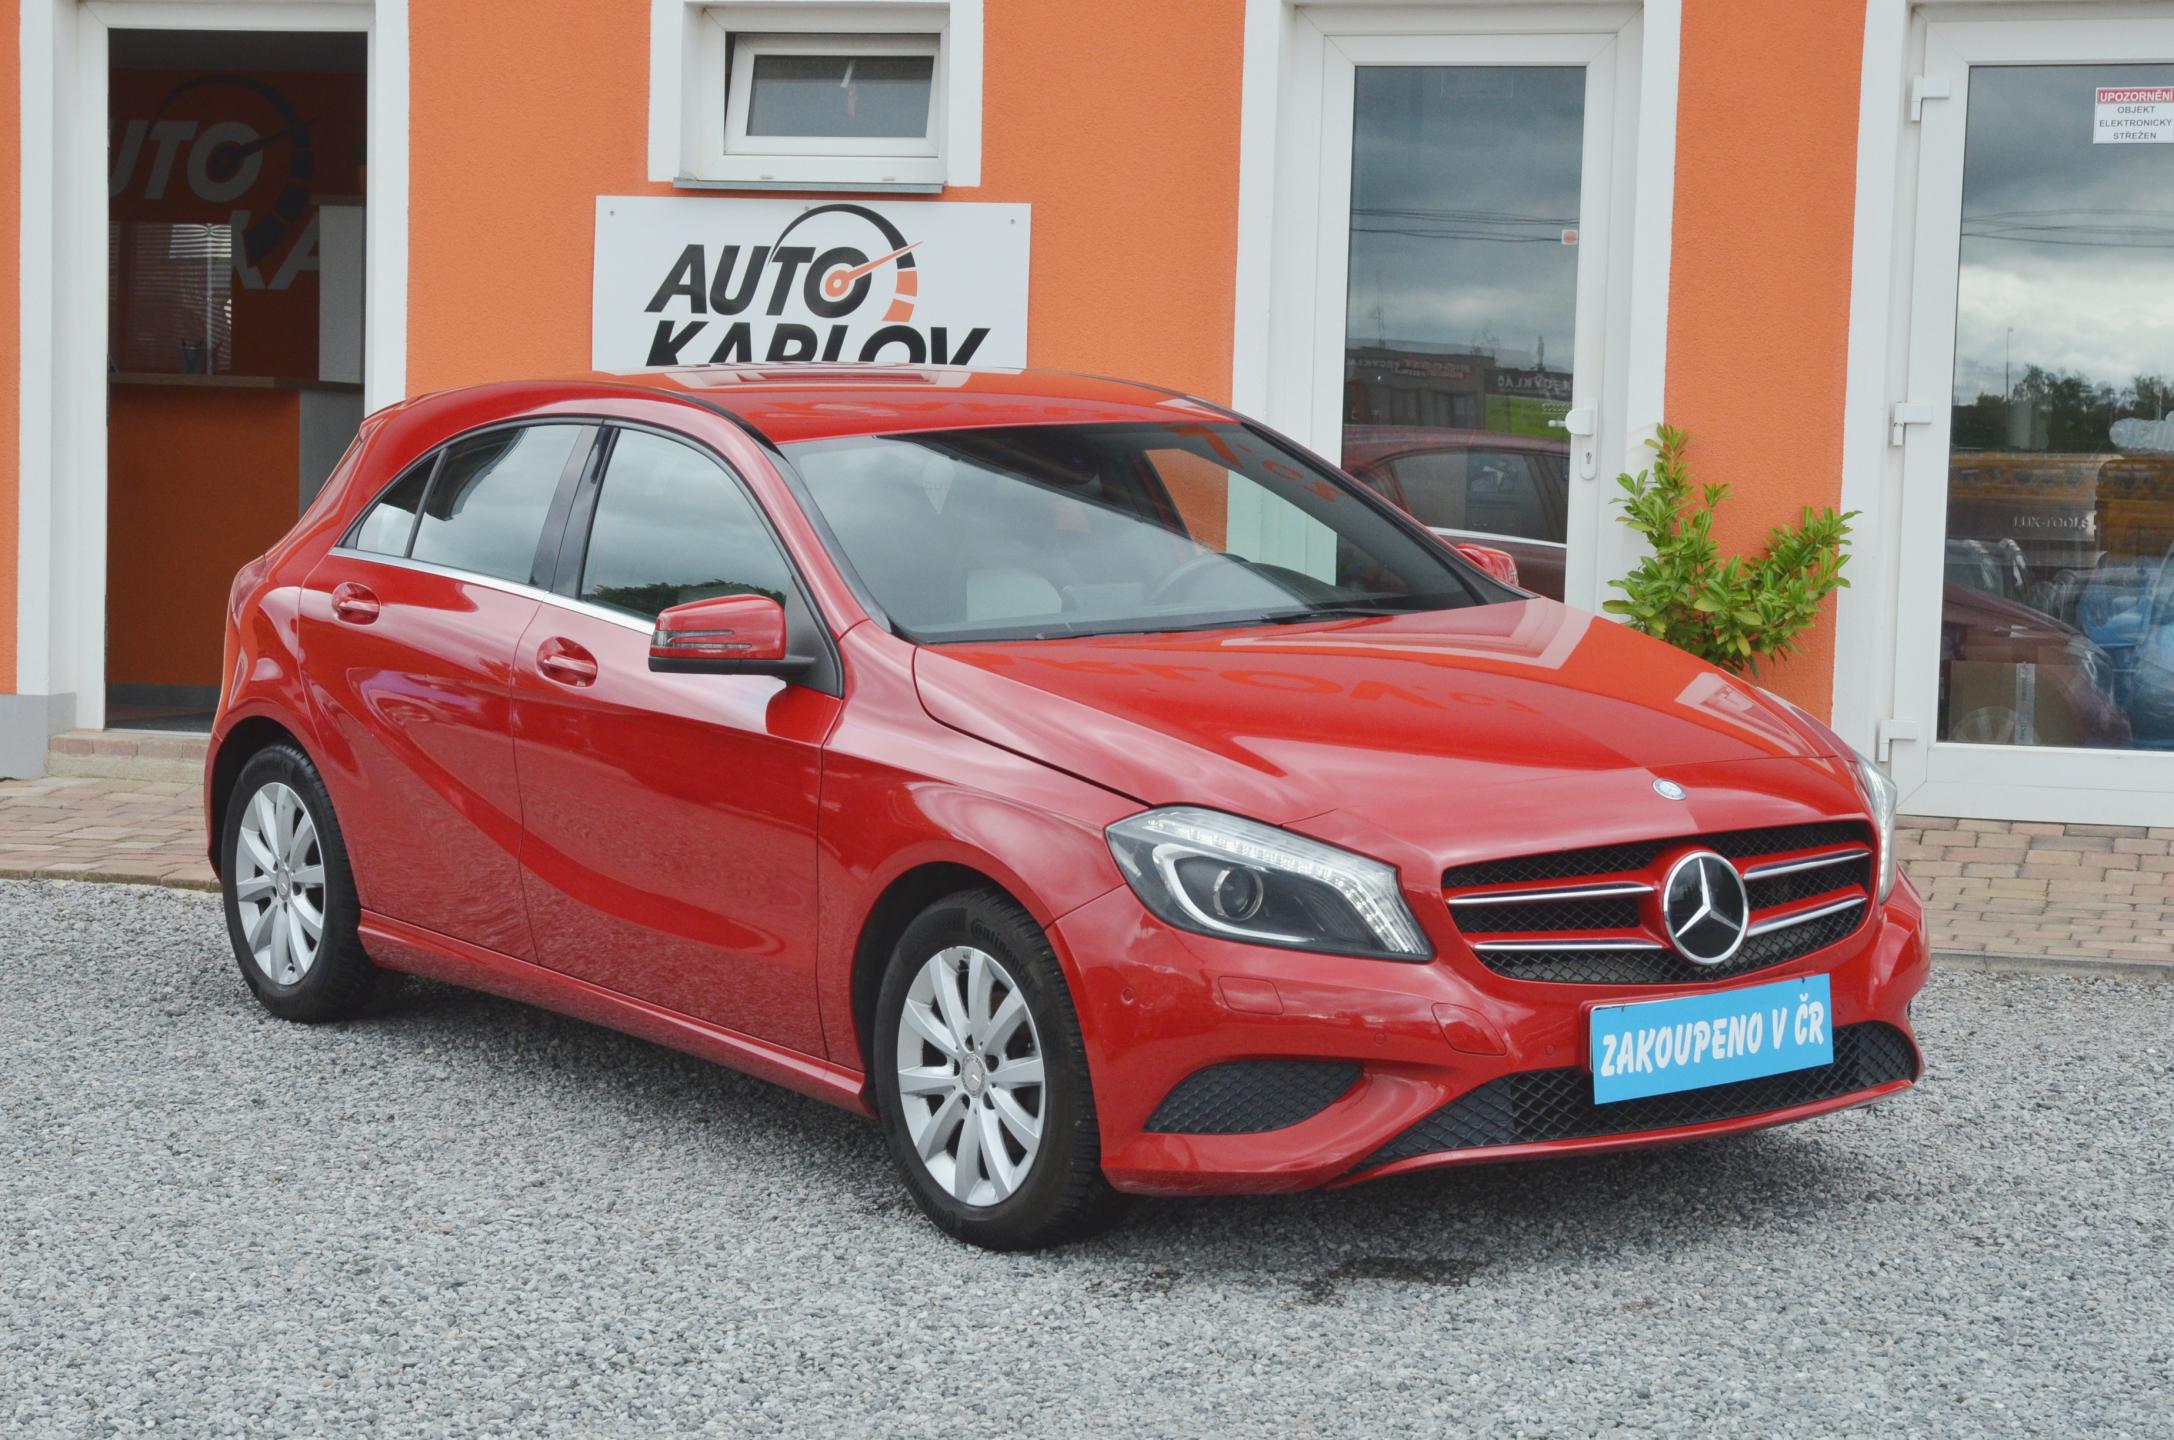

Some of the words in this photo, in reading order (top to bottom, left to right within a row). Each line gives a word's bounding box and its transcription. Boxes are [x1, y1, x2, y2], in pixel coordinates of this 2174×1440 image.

[2099, 89, 2174, 103] UPOZORNĚNÍ
[2117, 105, 2155, 114] OBJEKT
[2098, 118, 2173, 127] ELEKTRONICKY
[2113, 130, 2157, 140] STŘEŽEN
[644, 243, 873, 319] AUTO
[1600, 1011, 1763, 1077] ZAKOUPENO
[1772, 1007, 1788, 1050] V
[1794, 992, 1825, 1046] ČR
